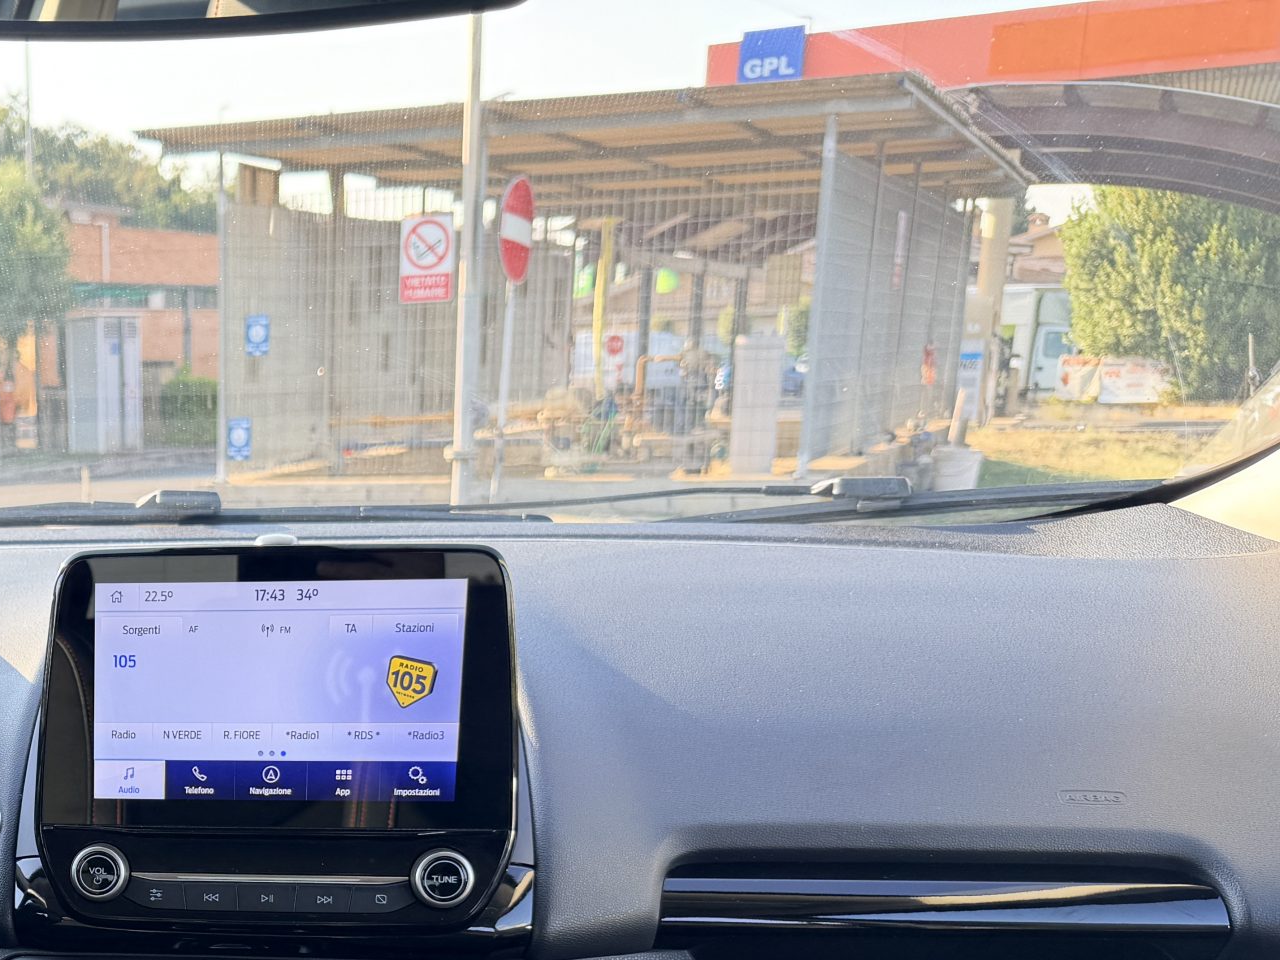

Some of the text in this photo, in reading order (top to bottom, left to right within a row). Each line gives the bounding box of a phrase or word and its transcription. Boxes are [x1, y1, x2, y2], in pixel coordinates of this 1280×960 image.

[743, 54, 796, 79] GPL
[144, 590, 174, 602] 22.5°
[254, 588, 319, 601] 17:43 34°
[122, 624, 161, 637] Sorgenti
[188, 625, 199, 633] AF
[279, 626, 291, 634] FM
[344, 623, 357, 634] TA
[394, 622, 435, 633] Stazioni
[113, 654, 136, 668] 105
[399, 662, 424, 673] RADIO
[391, 669, 427, 695] 105
[111, 730, 136, 740] Radio
[172, 730, 202, 740] VERDE
[223, 730, 261, 740] R. FIORE
[118, 785, 140, 794] Audio
[184, 786, 215, 795] Telefono
[249, 786, 293, 797] Navigazione
[335, 788, 351, 797] App
[393, 787, 441, 797] Impostazioni
[88, 866, 108, 875] VOL
[431, 875, 458, 884] TUNE
